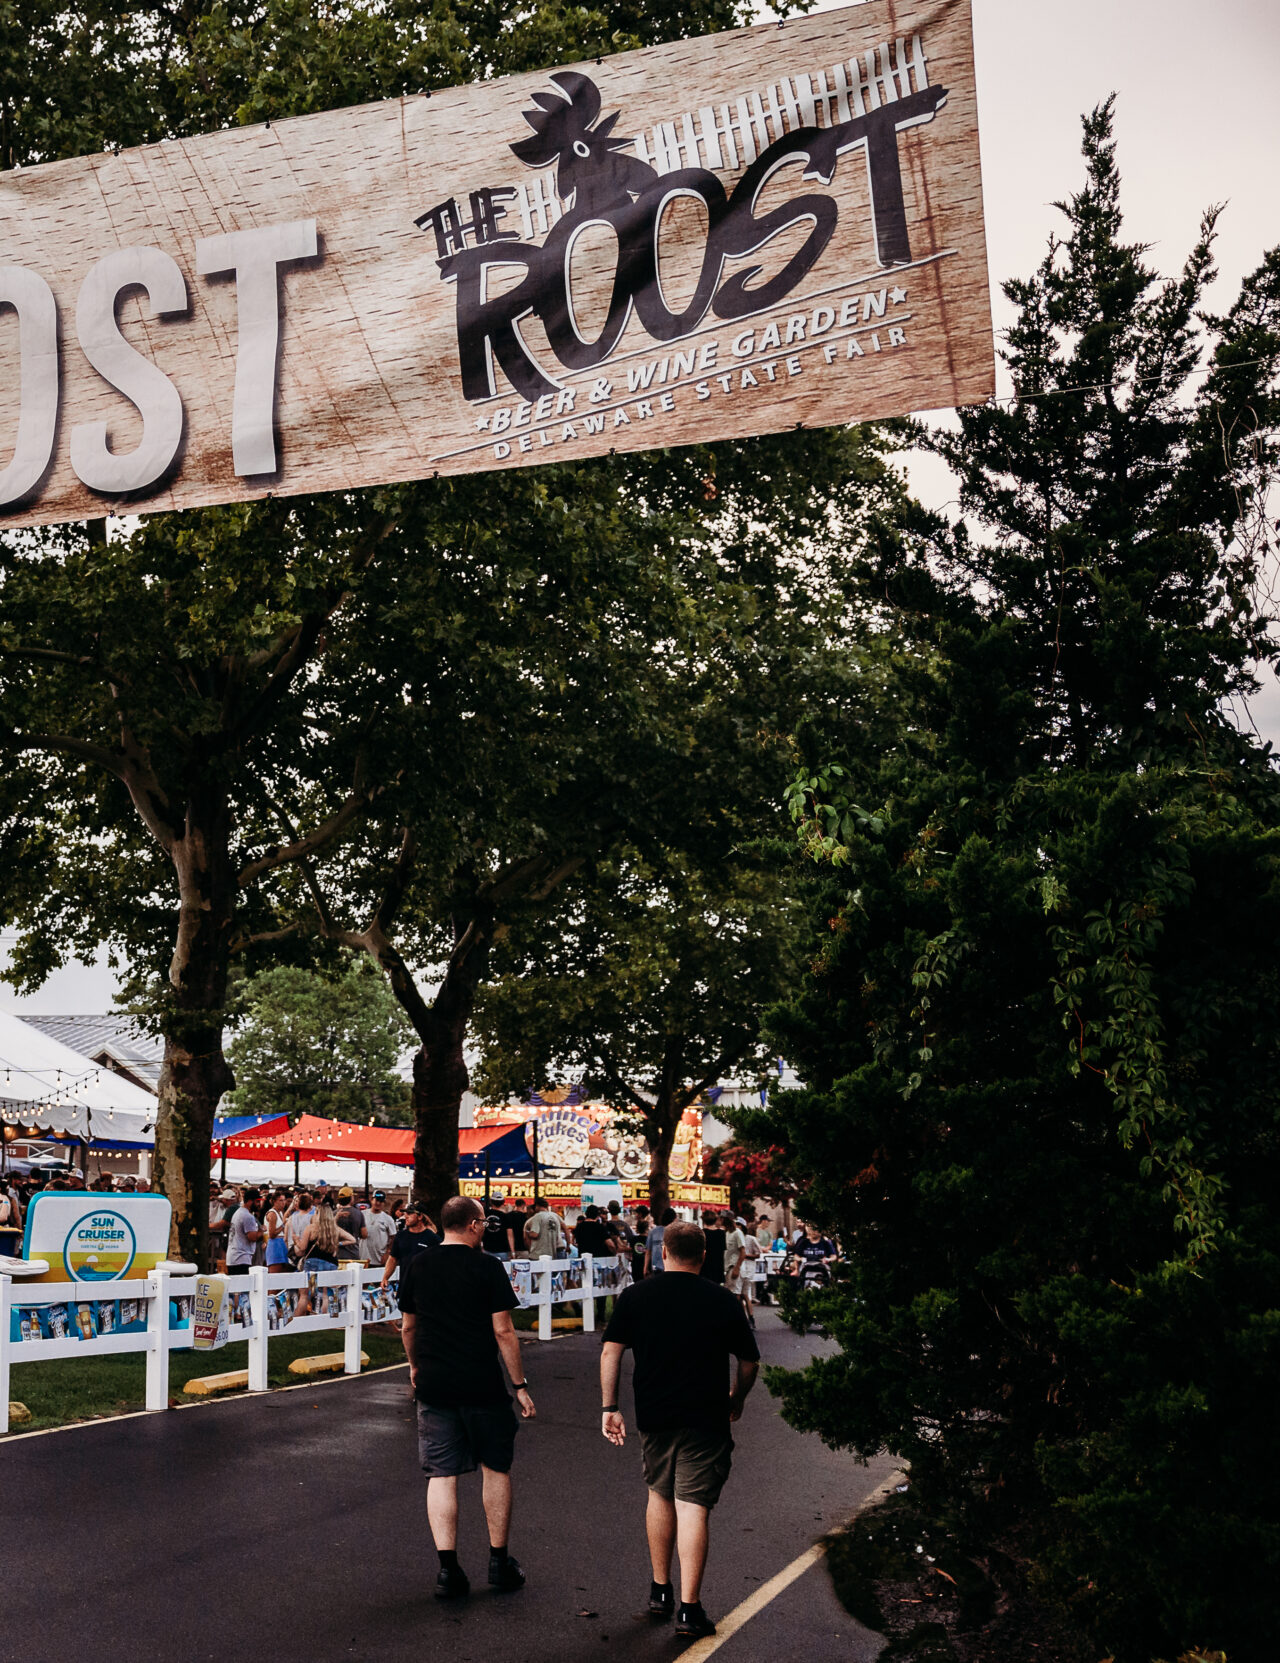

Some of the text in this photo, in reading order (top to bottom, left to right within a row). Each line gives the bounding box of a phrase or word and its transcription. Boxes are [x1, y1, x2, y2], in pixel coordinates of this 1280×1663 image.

[413, 187, 521, 259] THE
[436, 84, 949, 402] ROOST
[491, 289, 888, 435] BEER & WINE GARDEN
[494, 325, 907, 460] DELAWARE STATE FAIR
[91, 1217, 115, 1227] SUN
[545, 1183, 582, 1196] Chicke
[78, 1229, 125, 1239] CRUISER
